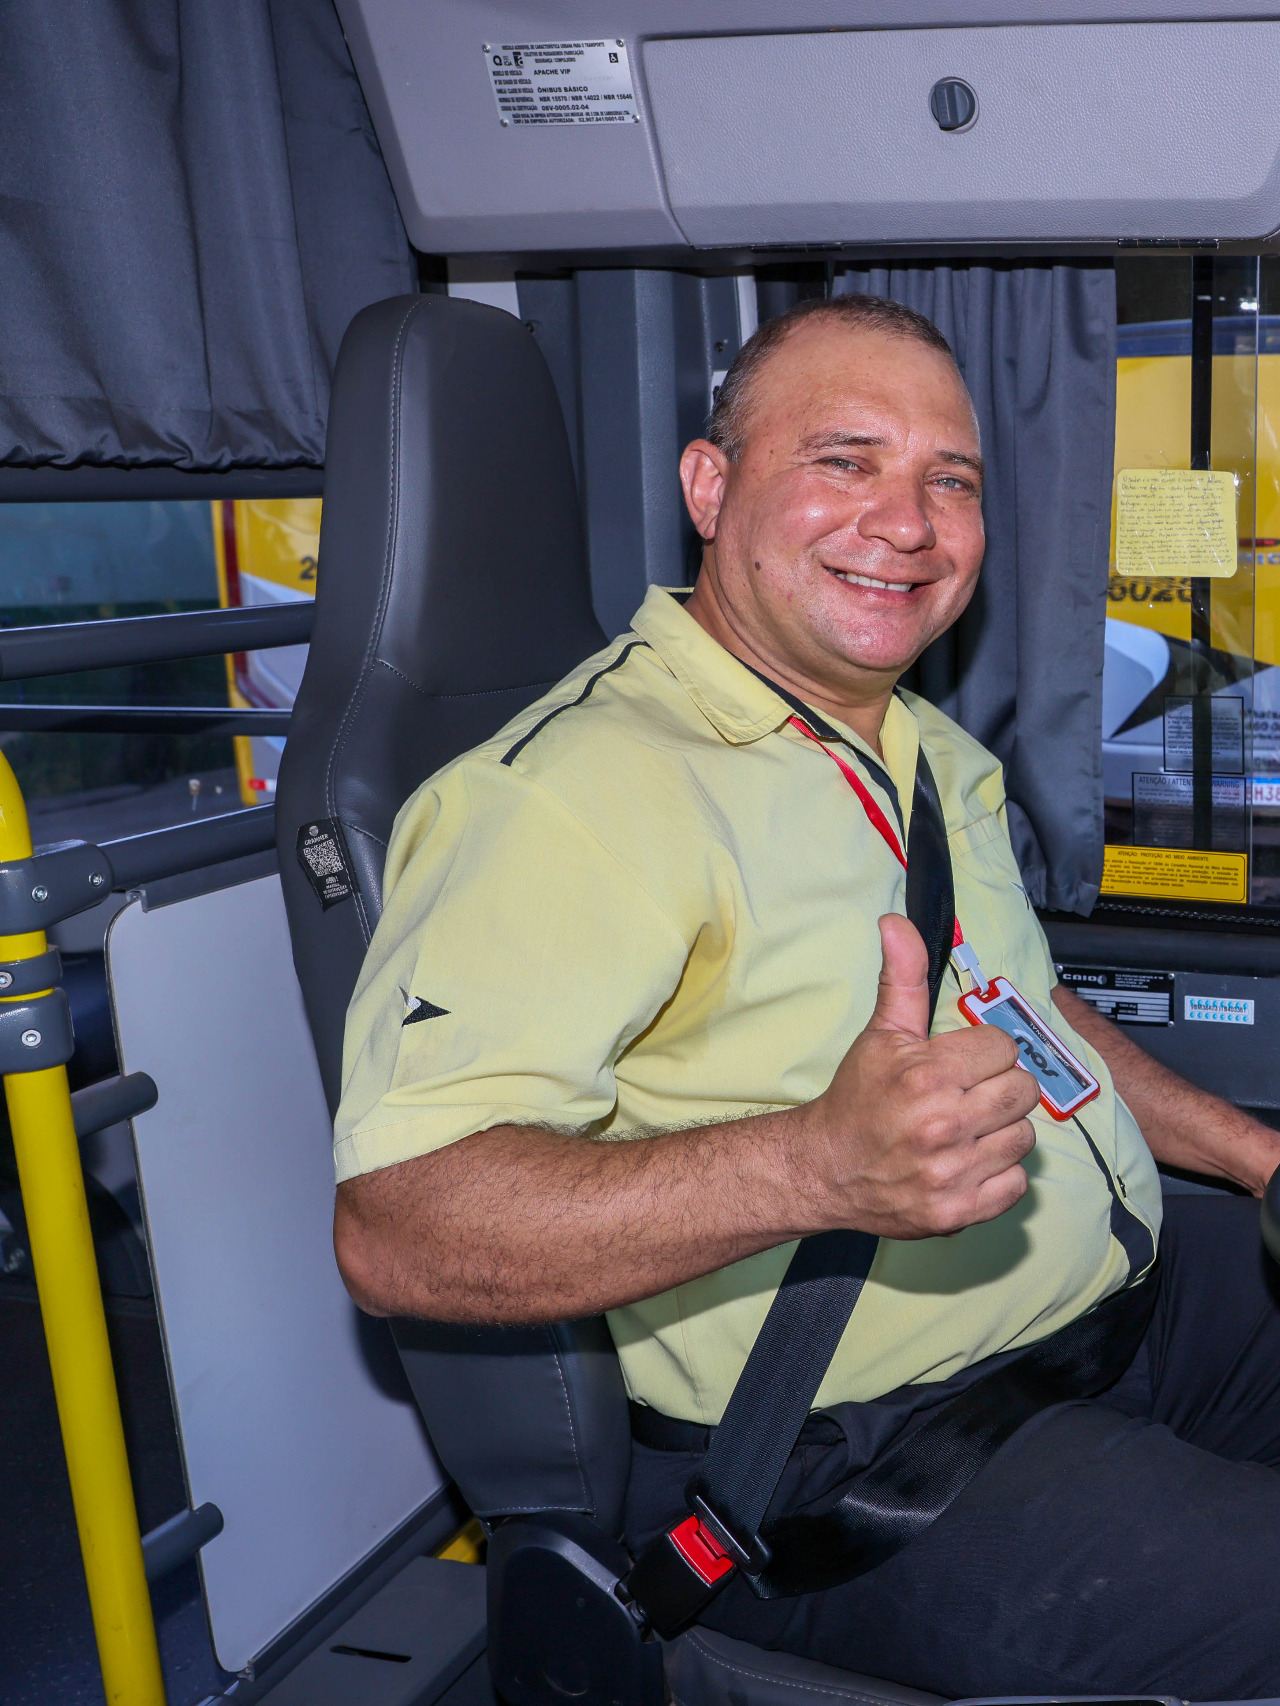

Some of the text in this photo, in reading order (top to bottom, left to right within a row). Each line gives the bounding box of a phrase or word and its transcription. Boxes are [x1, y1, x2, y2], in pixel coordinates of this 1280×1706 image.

[1138, 776, 1167, 786] ATENÇÃO
[304, 833, 329, 846] GRAMMER
[1062, 973, 1097, 982] CAIO
